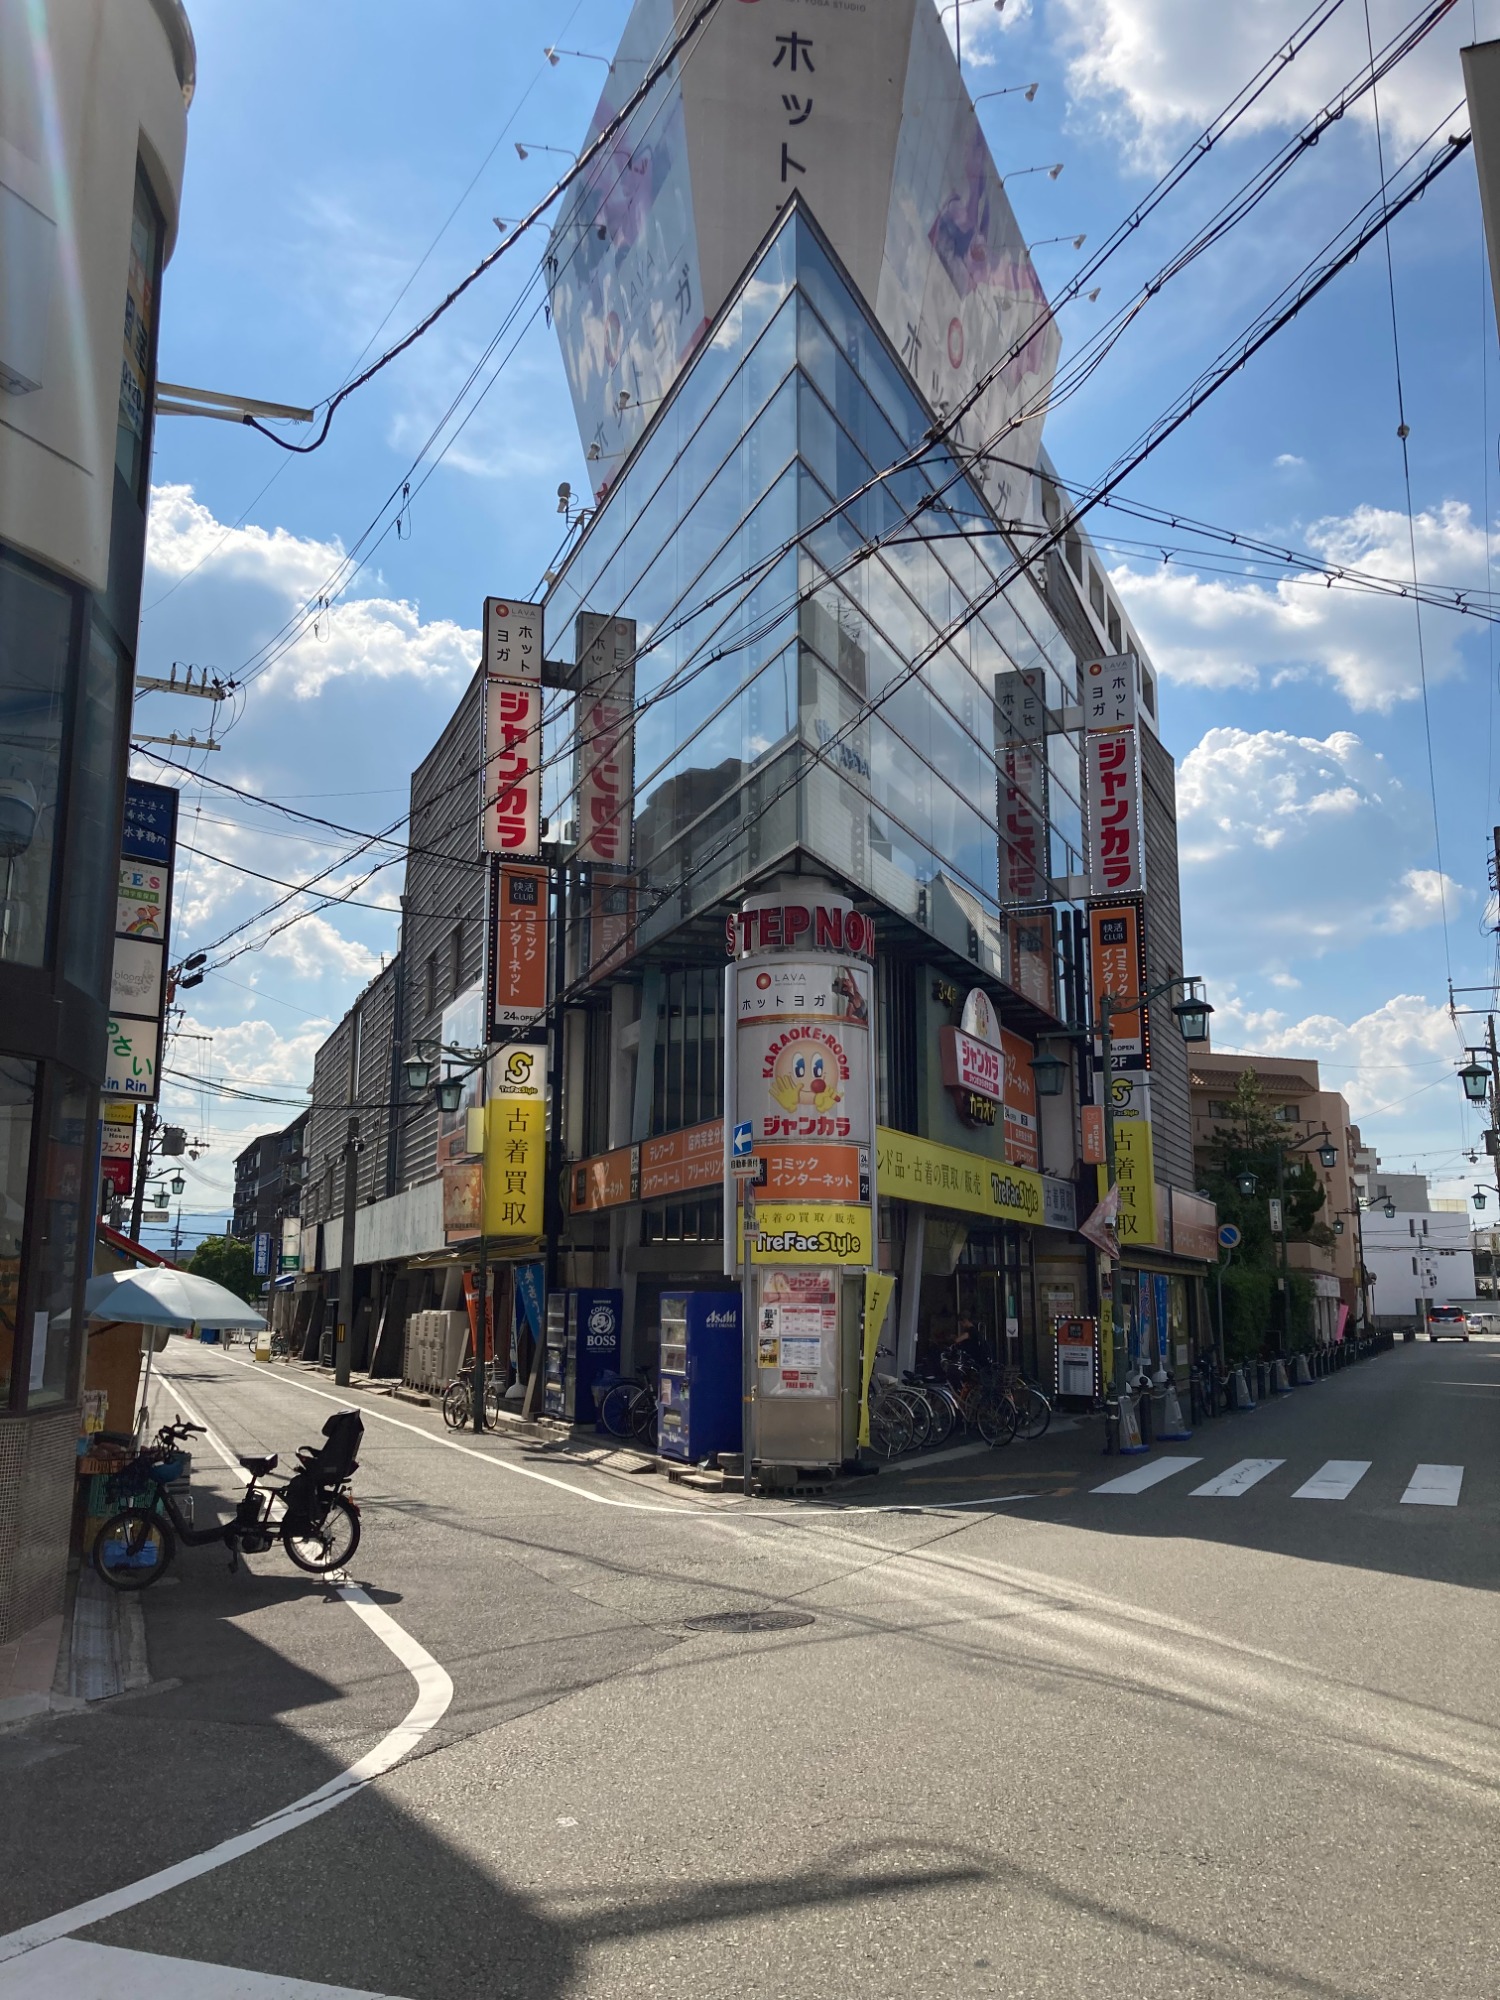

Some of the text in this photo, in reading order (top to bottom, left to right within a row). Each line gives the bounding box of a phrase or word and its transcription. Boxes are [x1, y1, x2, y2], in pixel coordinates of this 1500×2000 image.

[833, 2, 867, 13] STUDIO
[772, 31, 815, 211] ホット
[511, 607, 537, 618] LAVA
[496, 629, 511, 662] ヨガ
[518, 624, 533, 673] ホット
[1104, 660, 1128, 670] LAVA
[1092, 686, 1106, 717] ヨガ
[1112, 676, 1126, 721] ホット
[496, 691, 530, 849] ジャンカラ
[125, 797, 168, 812] 理士法人
[1098, 738, 1132, 888] ジャンカラ
[513, 881, 534, 893] 快活
[513, 892, 534, 901] CLUB
[524, 910, 537, 961] コミック
[726, 906, 811, 957] STEP
[1103, 922, 1123, 933] 快活
[1103, 932, 1124, 942] CLUB
[508, 909, 522, 997] インターネット
[114, 970, 144, 986] bloom
[774, 973, 807, 982] LAVA
[1115, 948, 1129, 996] コミック
[742, 994, 826, 1011] ホットヨガ
[962, 1040, 999, 1081] ジャンカラ
[1110, 1056, 1127, 1068] 2F
[125, 1078, 147, 1093] Rin
[1005, 1071, 1031, 1096] ターネット
[969, 1092, 997, 1122] カラオケ
[1113, 1109, 1140, 1117] FacStyle
[763, 1115, 851, 1137] ジャンカラ
[102, 1142, 130, 1153] フェスタ
[649, 1141, 675, 1162] テレワーク
[501, 1107, 530, 1227] 古着買取
[772, 1157, 819, 1171] コミック
[772, 1173, 853, 1188] インターネット
[1114, 1129, 1139, 1237] 古着買取
[990, 1172, 1039, 1218] TreFacStyle
[759, 1212, 856, 1225] 古着の買取/販売
[756, 1231, 861, 1258] TreFacStyle
[590, 1306, 614, 1315] COFFEE
[705, 1310, 737, 1323] Asahi
[586, 1335, 617, 1346] BOSS
